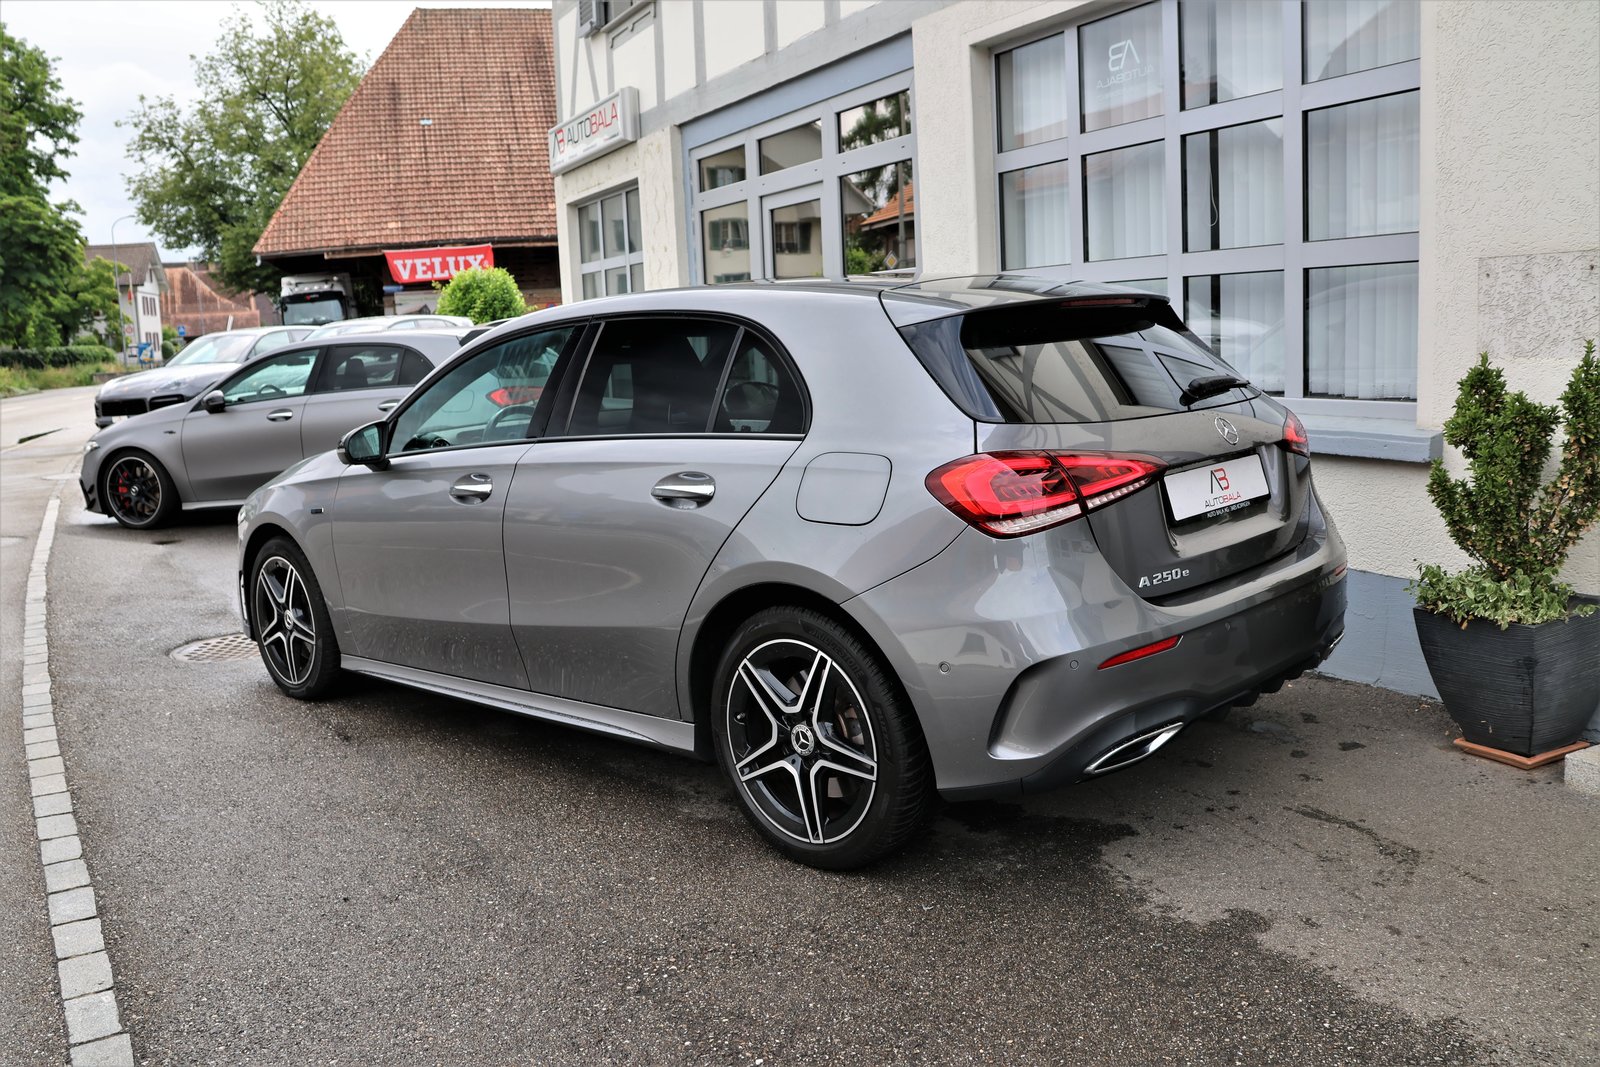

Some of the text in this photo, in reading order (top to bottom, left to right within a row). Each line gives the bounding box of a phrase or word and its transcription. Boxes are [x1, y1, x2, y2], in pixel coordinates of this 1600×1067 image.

[567, 102, 618, 145] AUTOBALA
[393, 254, 485, 280] VELUX
[1204, 491, 1241, 508] AUTOBALA
[1138, 567, 1190, 588] A 250e
